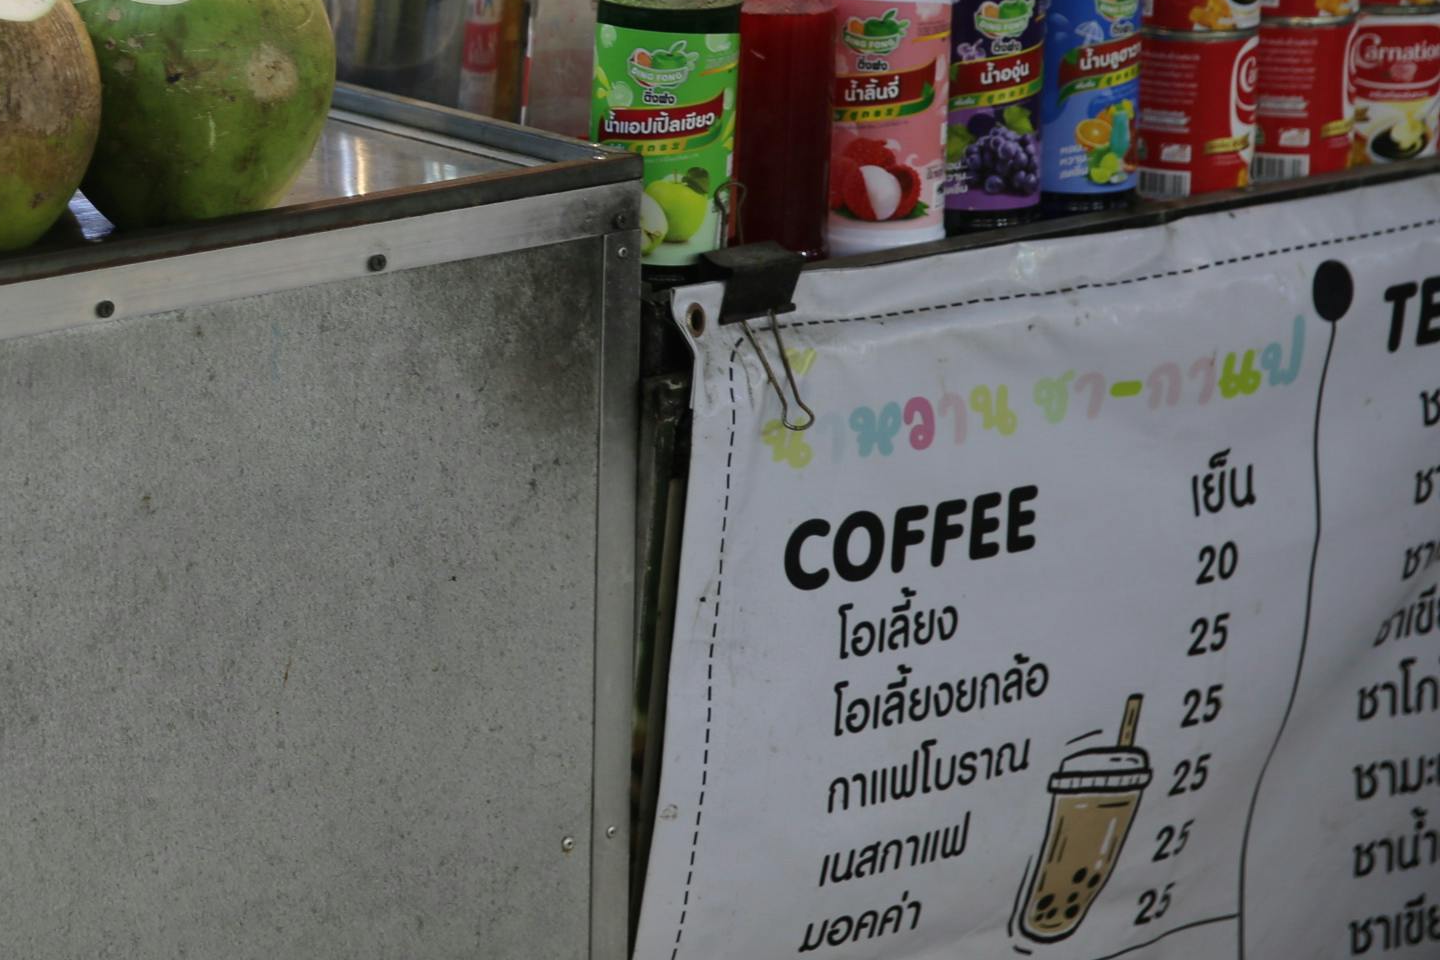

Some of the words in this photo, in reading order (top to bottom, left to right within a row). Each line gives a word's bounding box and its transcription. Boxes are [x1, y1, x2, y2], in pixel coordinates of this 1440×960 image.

[844, 76, 900, 102] น้ำลิ้นจี่
[980, 60, 1030, 85] น้ำองุ่น
[604, 111, 716, 135] น้ำแอปเปิ้ลเขียว
[1192, 448, 1257, 517] เย็น
[784, 485, 1038, 591] COFFEE
[838, 587, 959, 660] โอเลี้ยง
[1196, 541, 1239, 586] 20
[833, 653, 1050, 737] โอเลี้ยงยกล้อ
[1187, 613, 1231, 657] 25
[827, 738, 1031, 814] กาแฟโบราณ
[1180, 684, 1224, 728] 25
[1167, 754, 1212, 797] 25
[1353, 753, 1440, 800] ชามะ
[818, 812, 972, 887] เนสกาแฟ
[1151, 819, 1196, 863] 25
[797, 891, 922, 953] มอคค่า
[1133, 882, 1177, 926] 25
